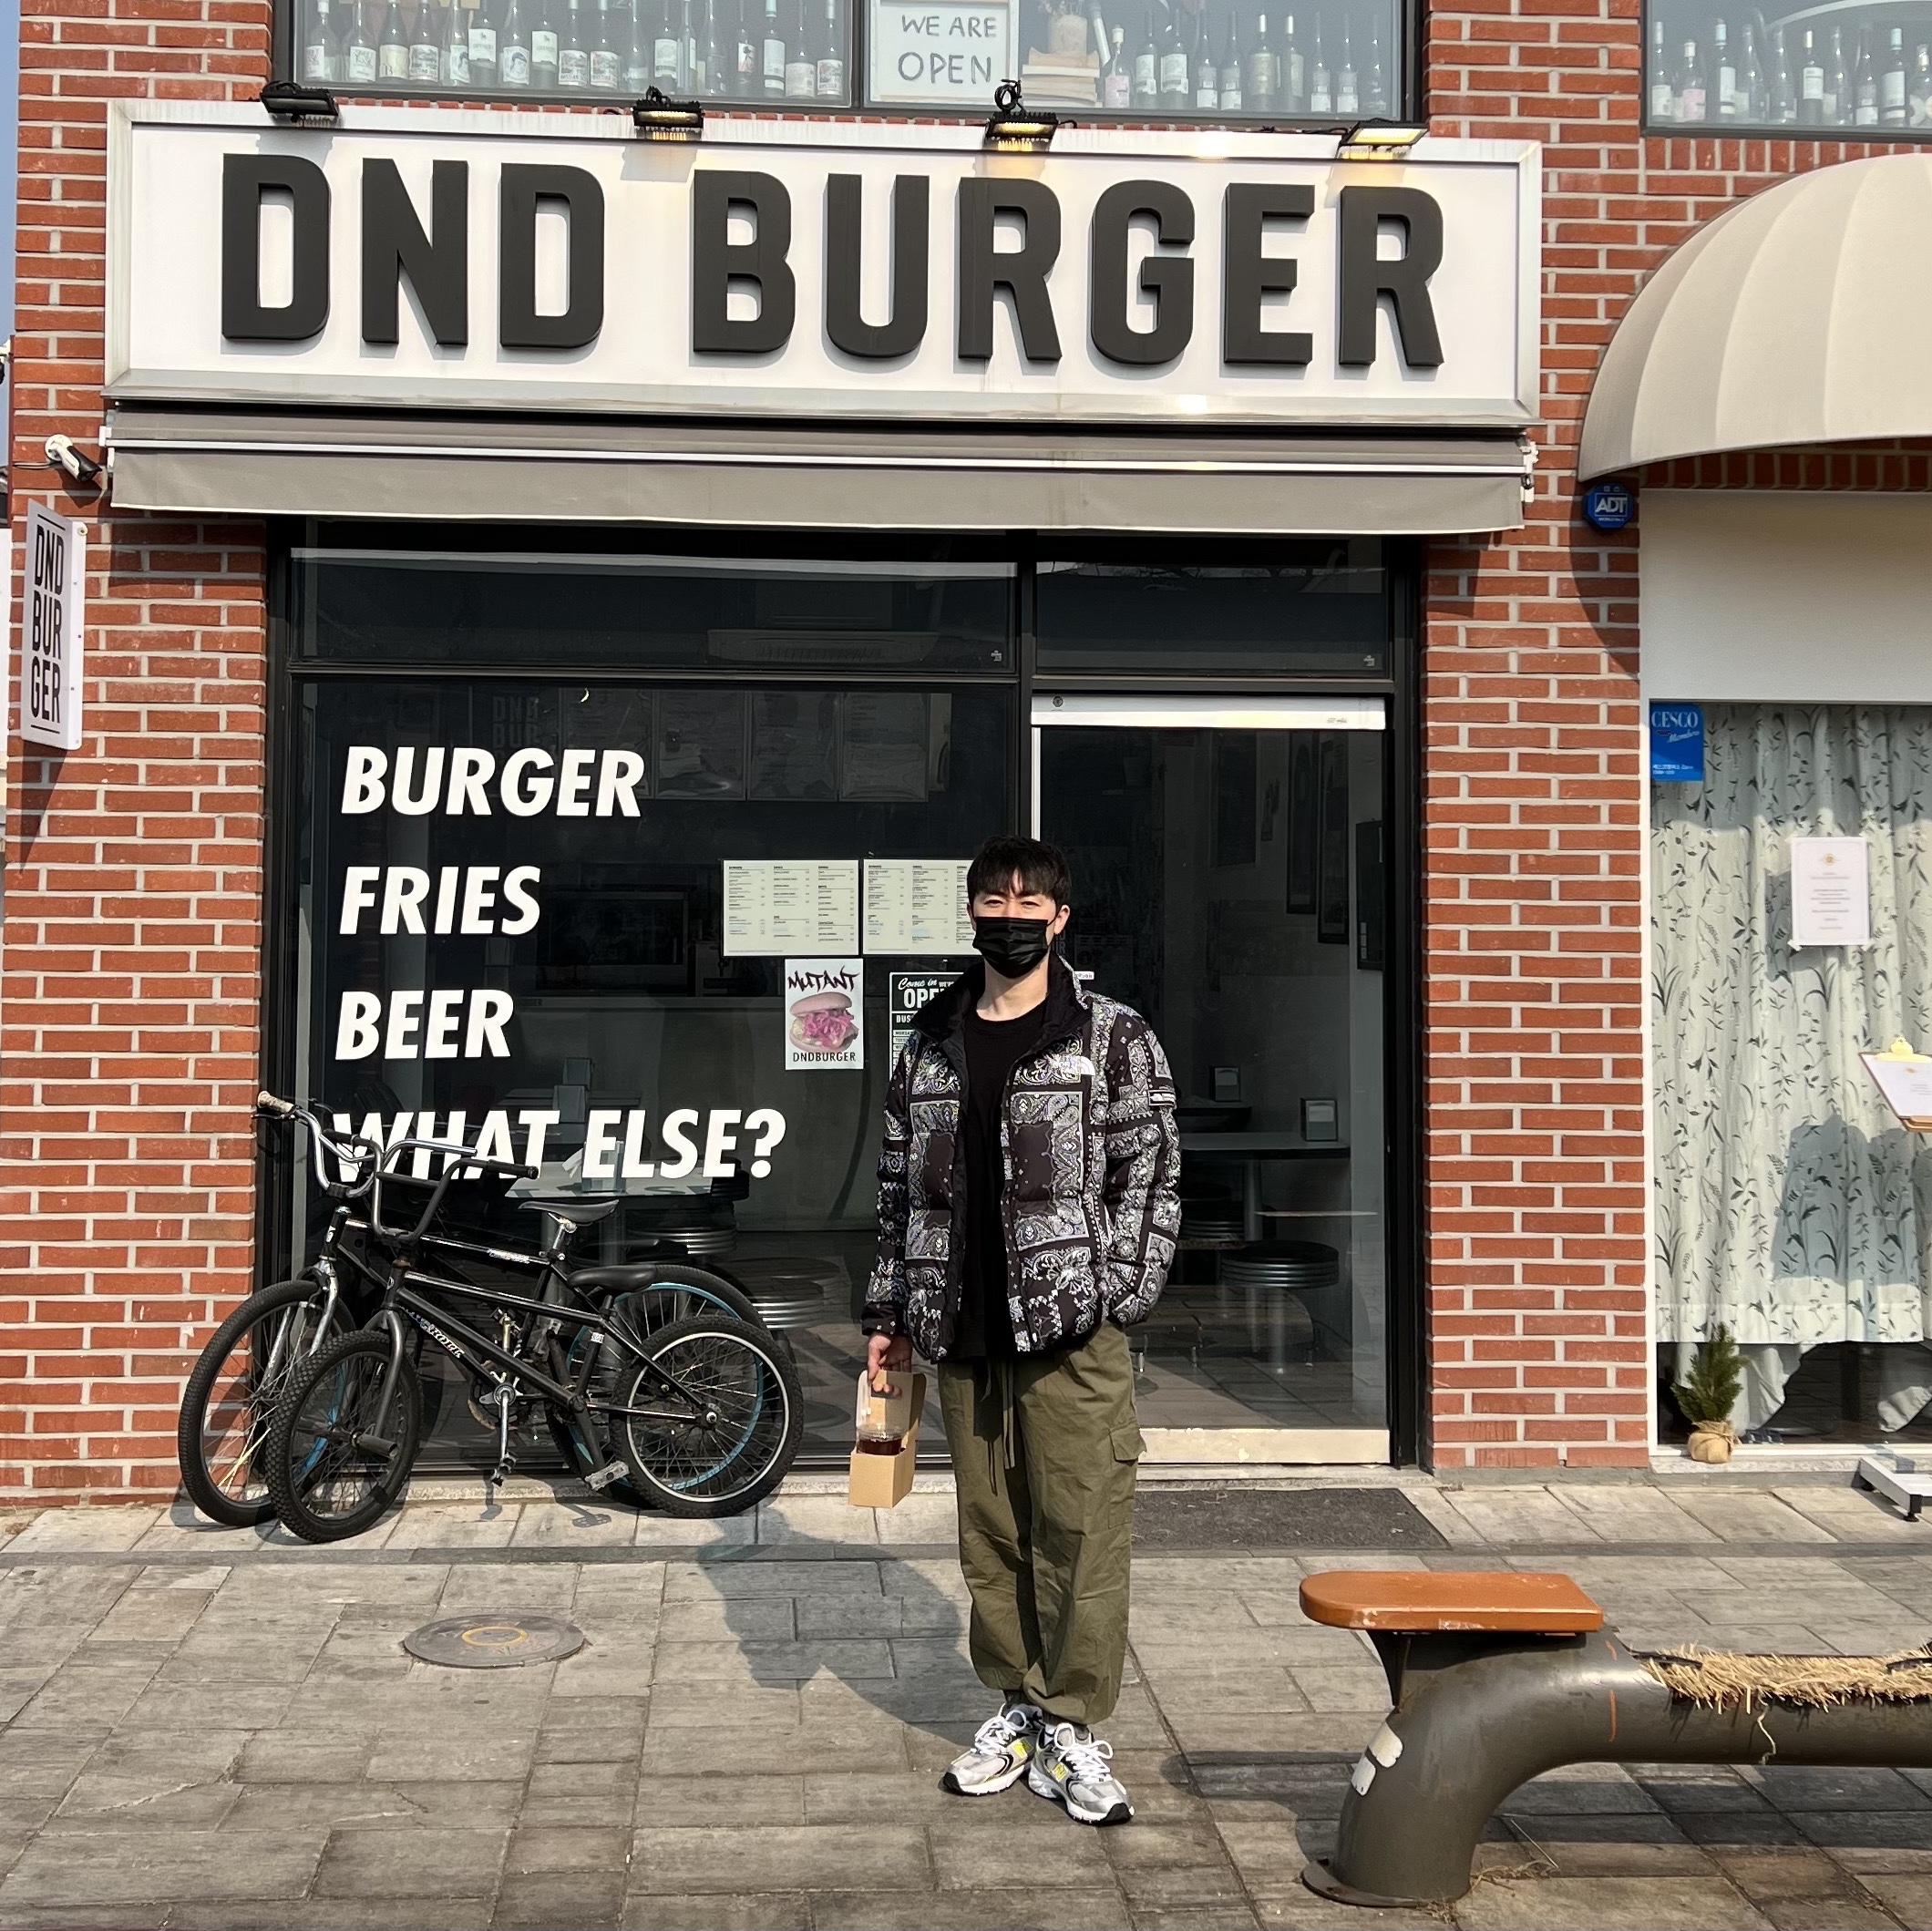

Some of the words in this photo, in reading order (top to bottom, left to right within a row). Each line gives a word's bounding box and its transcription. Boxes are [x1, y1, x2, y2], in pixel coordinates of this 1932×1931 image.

[902, 15, 940, 36] WE
[949, 16, 997, 37] ARE
[899, 52, 992, 84] OPEN
[221, 153, 604, 348] DND
[693, 169, 1444, 367] BURGER
[1595, 498, 1628, 512] ADT
[34, 524, 65, 595] DND
[31, 590, 61, 660] BUR
[30, 655, 60, 724] GER
[1651, 711, 1699, 728] CESCO
[341, 745, 645, 817] BURGER
[339, 866, 541, 936] FRIES
[787, 965, 860, 992] MUTANT
[898, 978, 925, 990] Come
[928, 978, 937, 986] in
[903, 988, 944, 1008] OP
[334, 990, 515, 1061] BEER
[793, 1052, 856, 1062] DNDBURGER
[333, 1109, 560, 1183] WHAT
[581, 1108, 786, 1179] ELSE?
